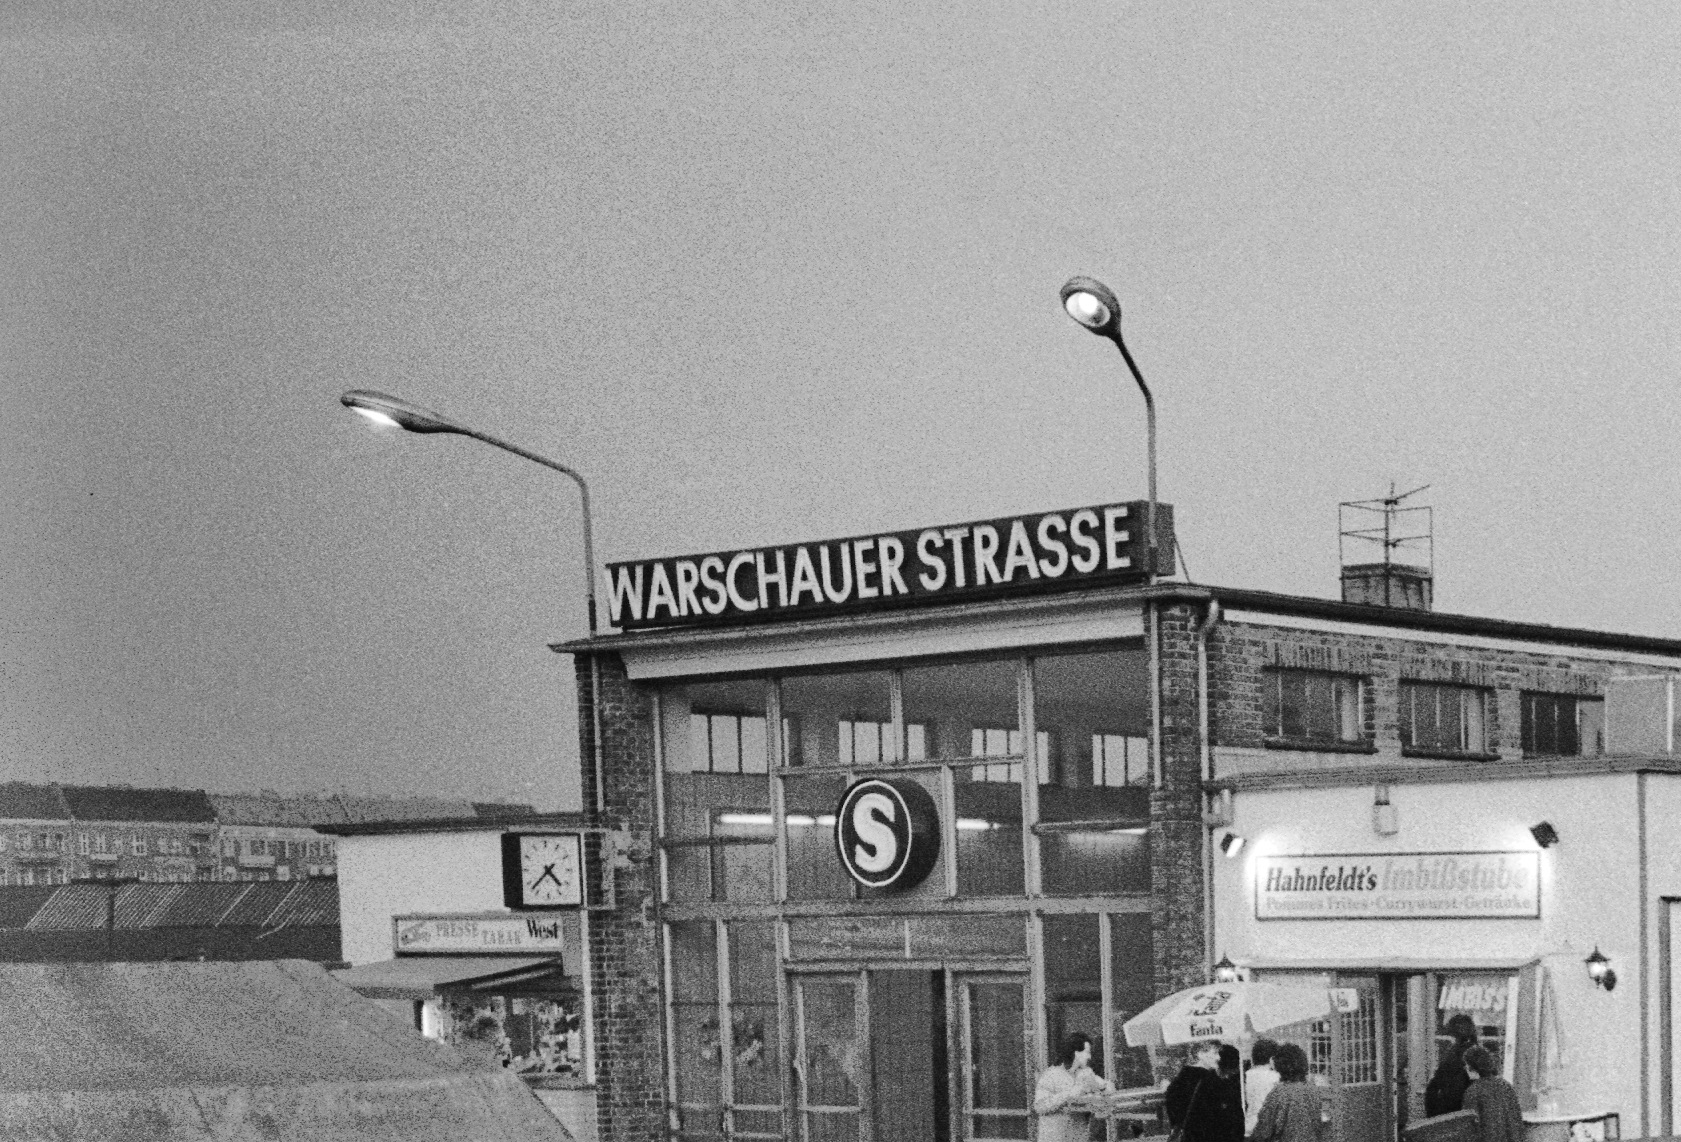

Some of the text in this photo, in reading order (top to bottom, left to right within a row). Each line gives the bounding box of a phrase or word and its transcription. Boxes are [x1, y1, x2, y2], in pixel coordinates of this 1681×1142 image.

[605, 506, 1133, 622] WARSCHAUER STRASSE
[853, 792, 896, 873] S
[1265, 859, 1530, 892] Hahnfeldt's Imbißstube
[1266, 897, 1323, 910] Pommes
[1329, 896, 1369, 910] Frites
[435, 921, 479, 938] PRESSE
[526, 917, 559, 940] West
